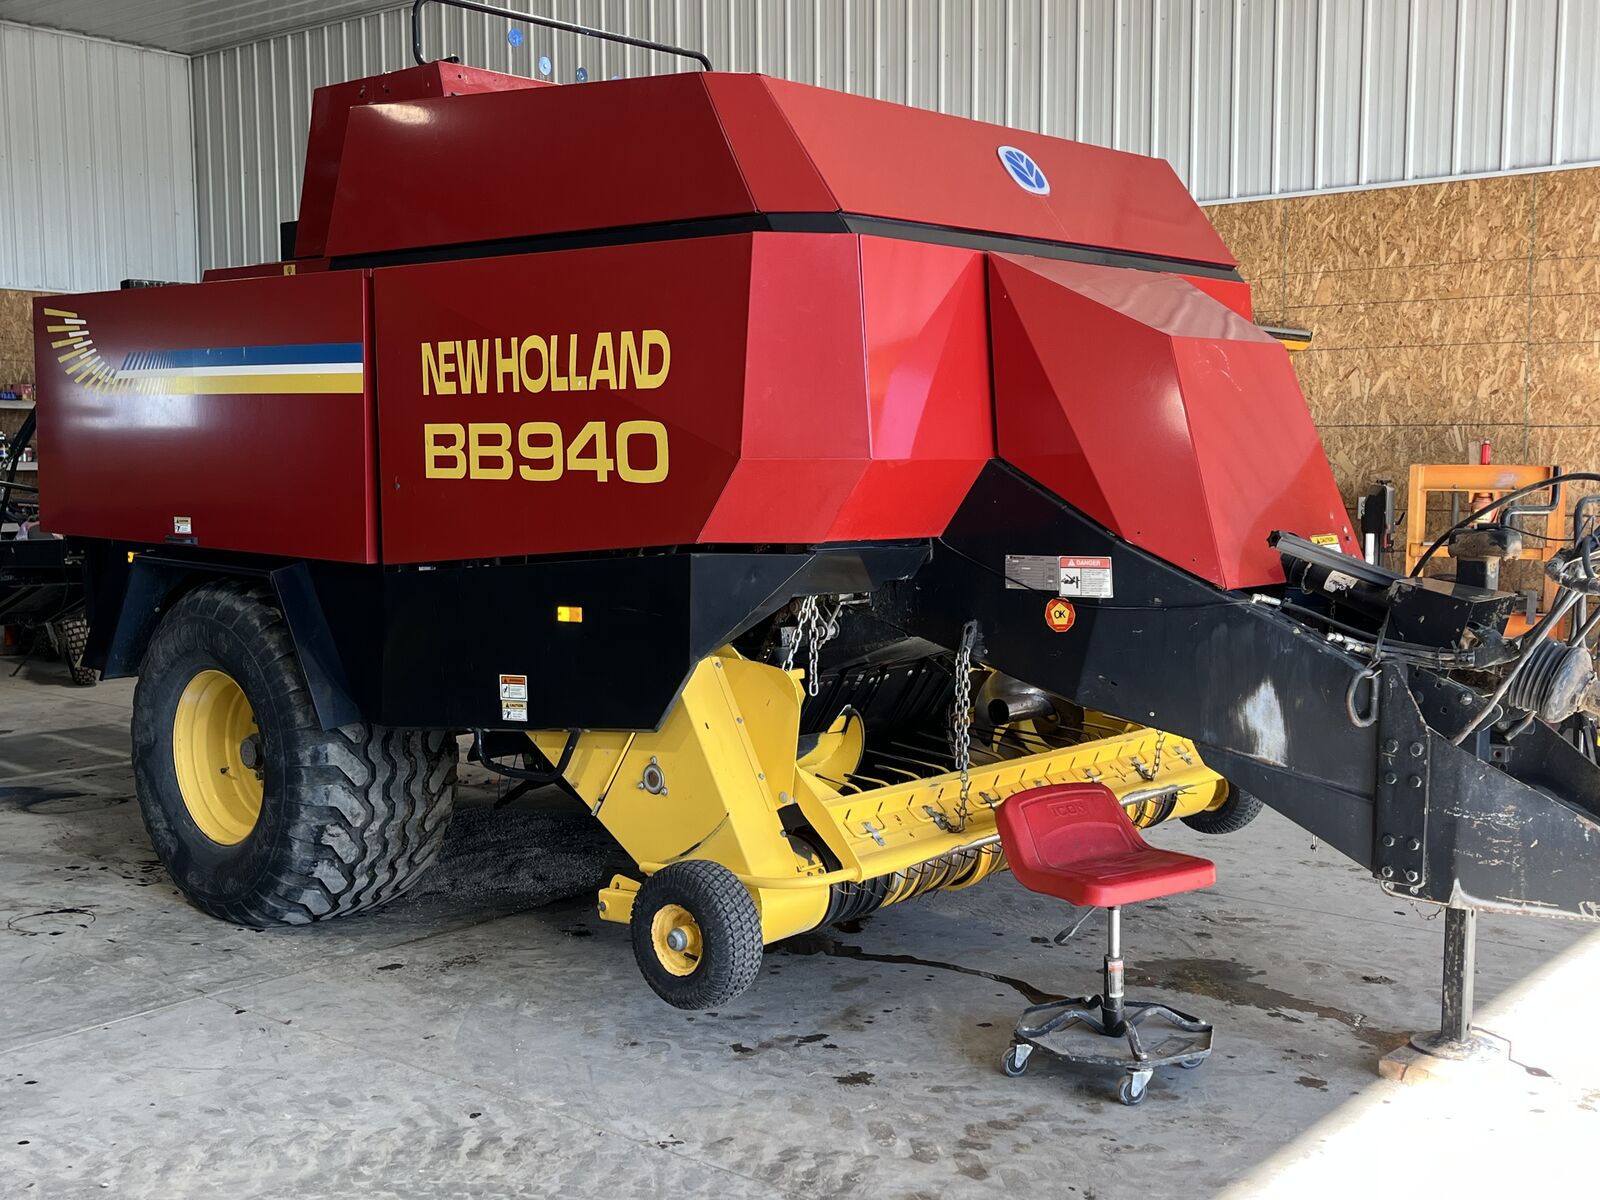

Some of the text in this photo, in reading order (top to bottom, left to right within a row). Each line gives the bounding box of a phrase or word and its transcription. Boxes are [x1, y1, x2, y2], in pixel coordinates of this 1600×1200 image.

[421, 329, 671, 395] NEW HOLLAND
[424, 420, 669, 483] BB940
[1075, 559, 1101, 567] DANGER
[1053, 609, 1066, 619] OK
